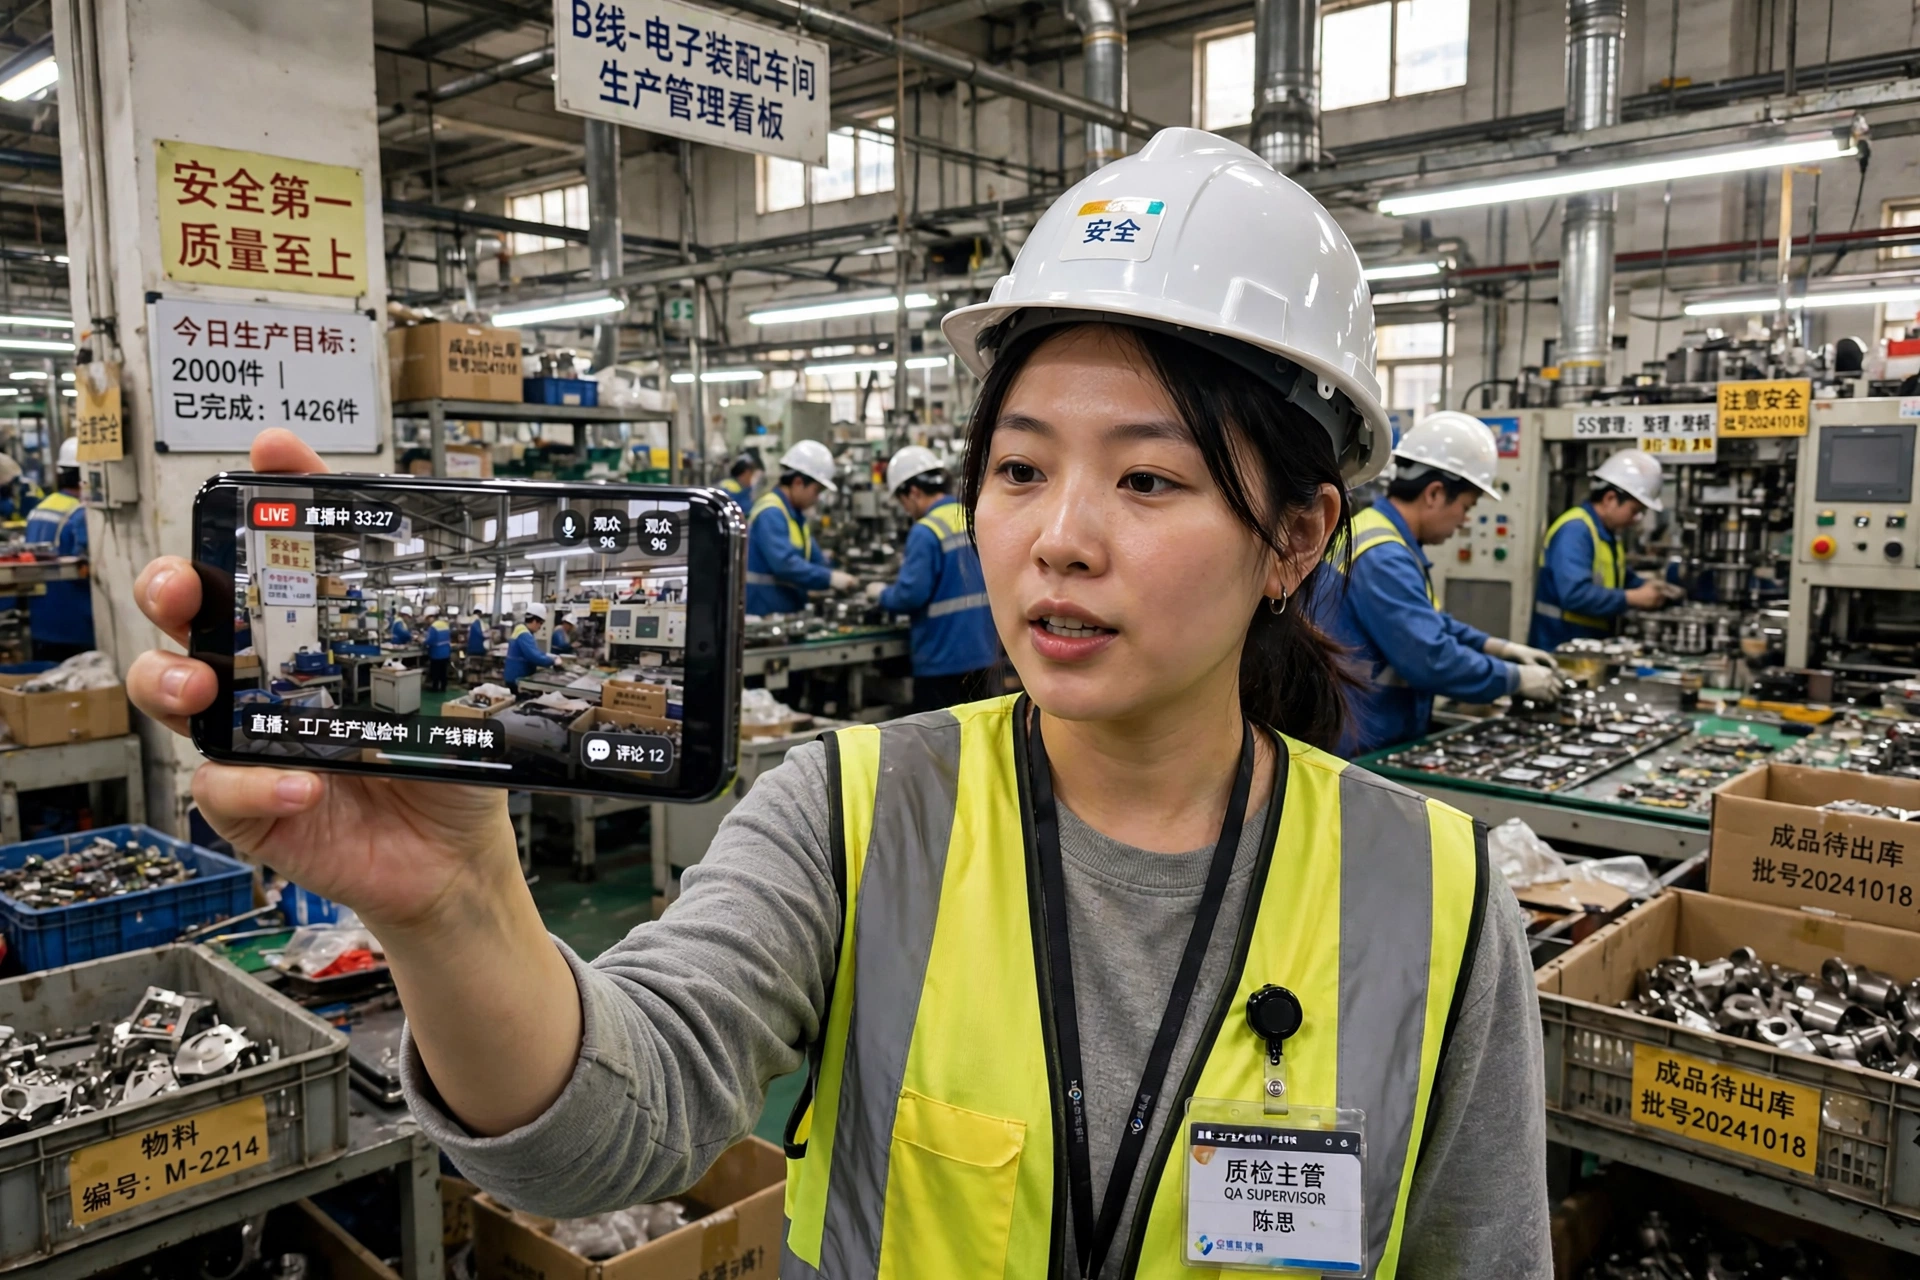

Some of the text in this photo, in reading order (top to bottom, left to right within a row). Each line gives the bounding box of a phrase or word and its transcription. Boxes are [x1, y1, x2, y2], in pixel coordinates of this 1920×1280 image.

[572, 0, 816, 101] B线-电子装配车间
[599, 60, 784, 141] 生产管理看板
[173, 160, 352, 220] 安全第一
[1083, 218, 1141, 243] 安全
[178, 222, 355, 281] 质量至上
[172, 358, 264, 386] 2000件
[1724, 388, 1802, 410] 注意安全
[260, 508, 290, 522] LIVE
[305, 507, 393, 526] 直播中 33:27
[593, 516, 621, 532] 观众
[645, 518, 673, 535] 观众
[600, 536, 616, 549] 96
[651, 538, 667, 551] 96
[429, 726, 494, 749] 产线审核
[616, 744, 665, 762] 评论 12
[1770, 823, 1905, 868] 成品待出库
[1752, 856, 1913, 907] 批号20241018
[1655, 1059, 1795, 1119] 成品待出库
[1641, 1089, 1806, 1158] 批号20241018
[141, 1120, 199, 1160] 物料
[1224, 1159, 1325, 1189] 质检主管
[1224, 1187, 1326, 1205] QA SUPERVISOR
[1253, 1209, 1296, 1233] 陈思
